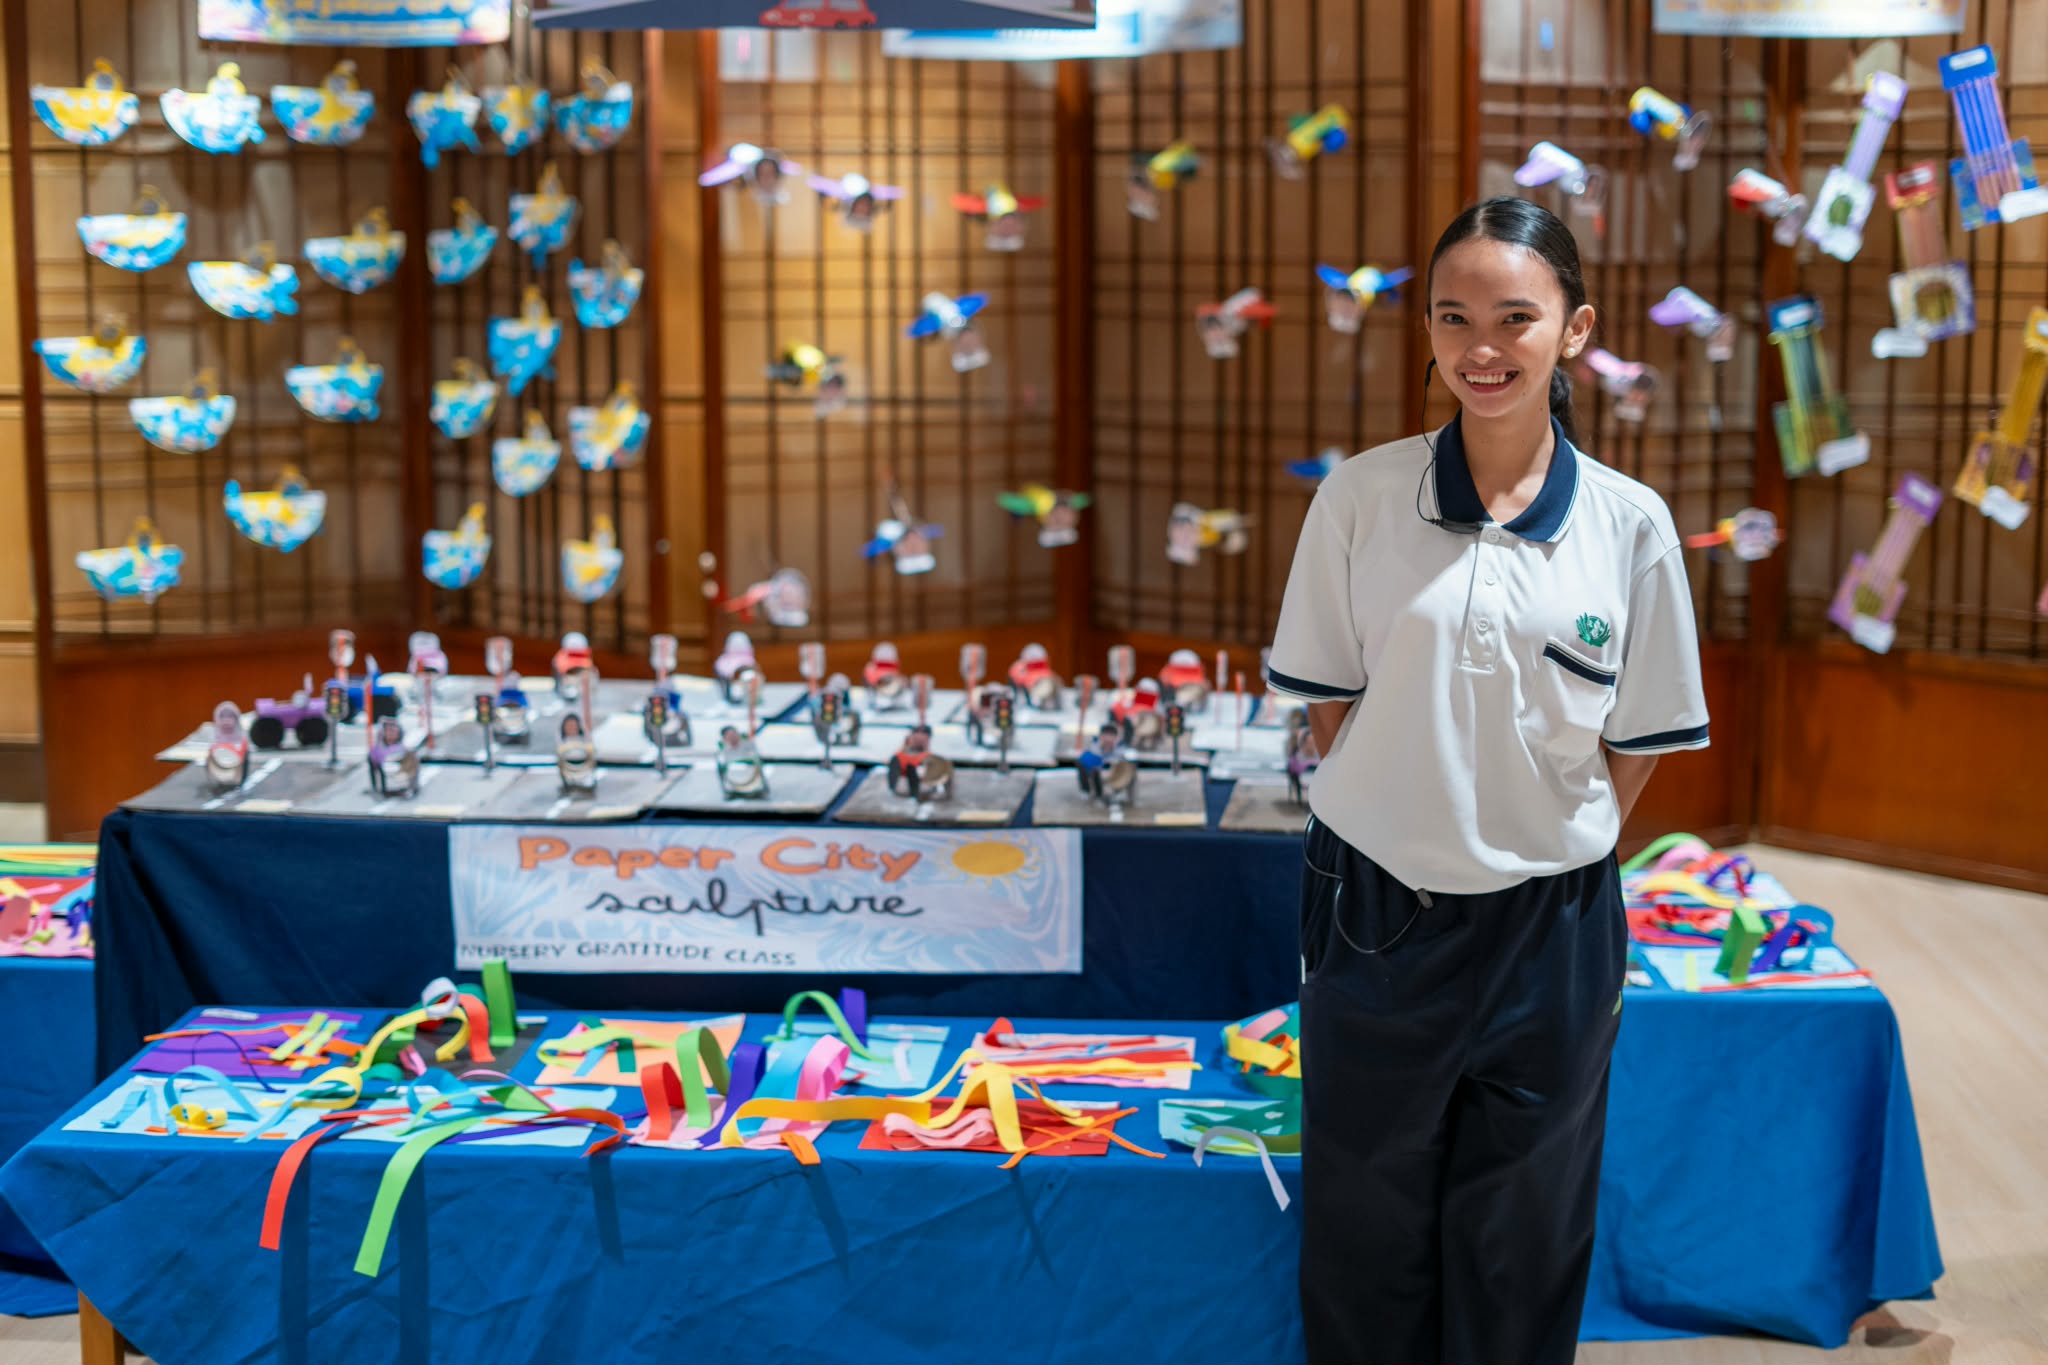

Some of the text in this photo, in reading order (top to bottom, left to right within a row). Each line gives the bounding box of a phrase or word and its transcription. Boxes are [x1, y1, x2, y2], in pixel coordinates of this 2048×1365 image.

[517, 836, 922, 882] Paper City
[586, 878, 924, 936] sculpture
[460, 941, 797, 966] NURSERY GRATITUDE CLASS
